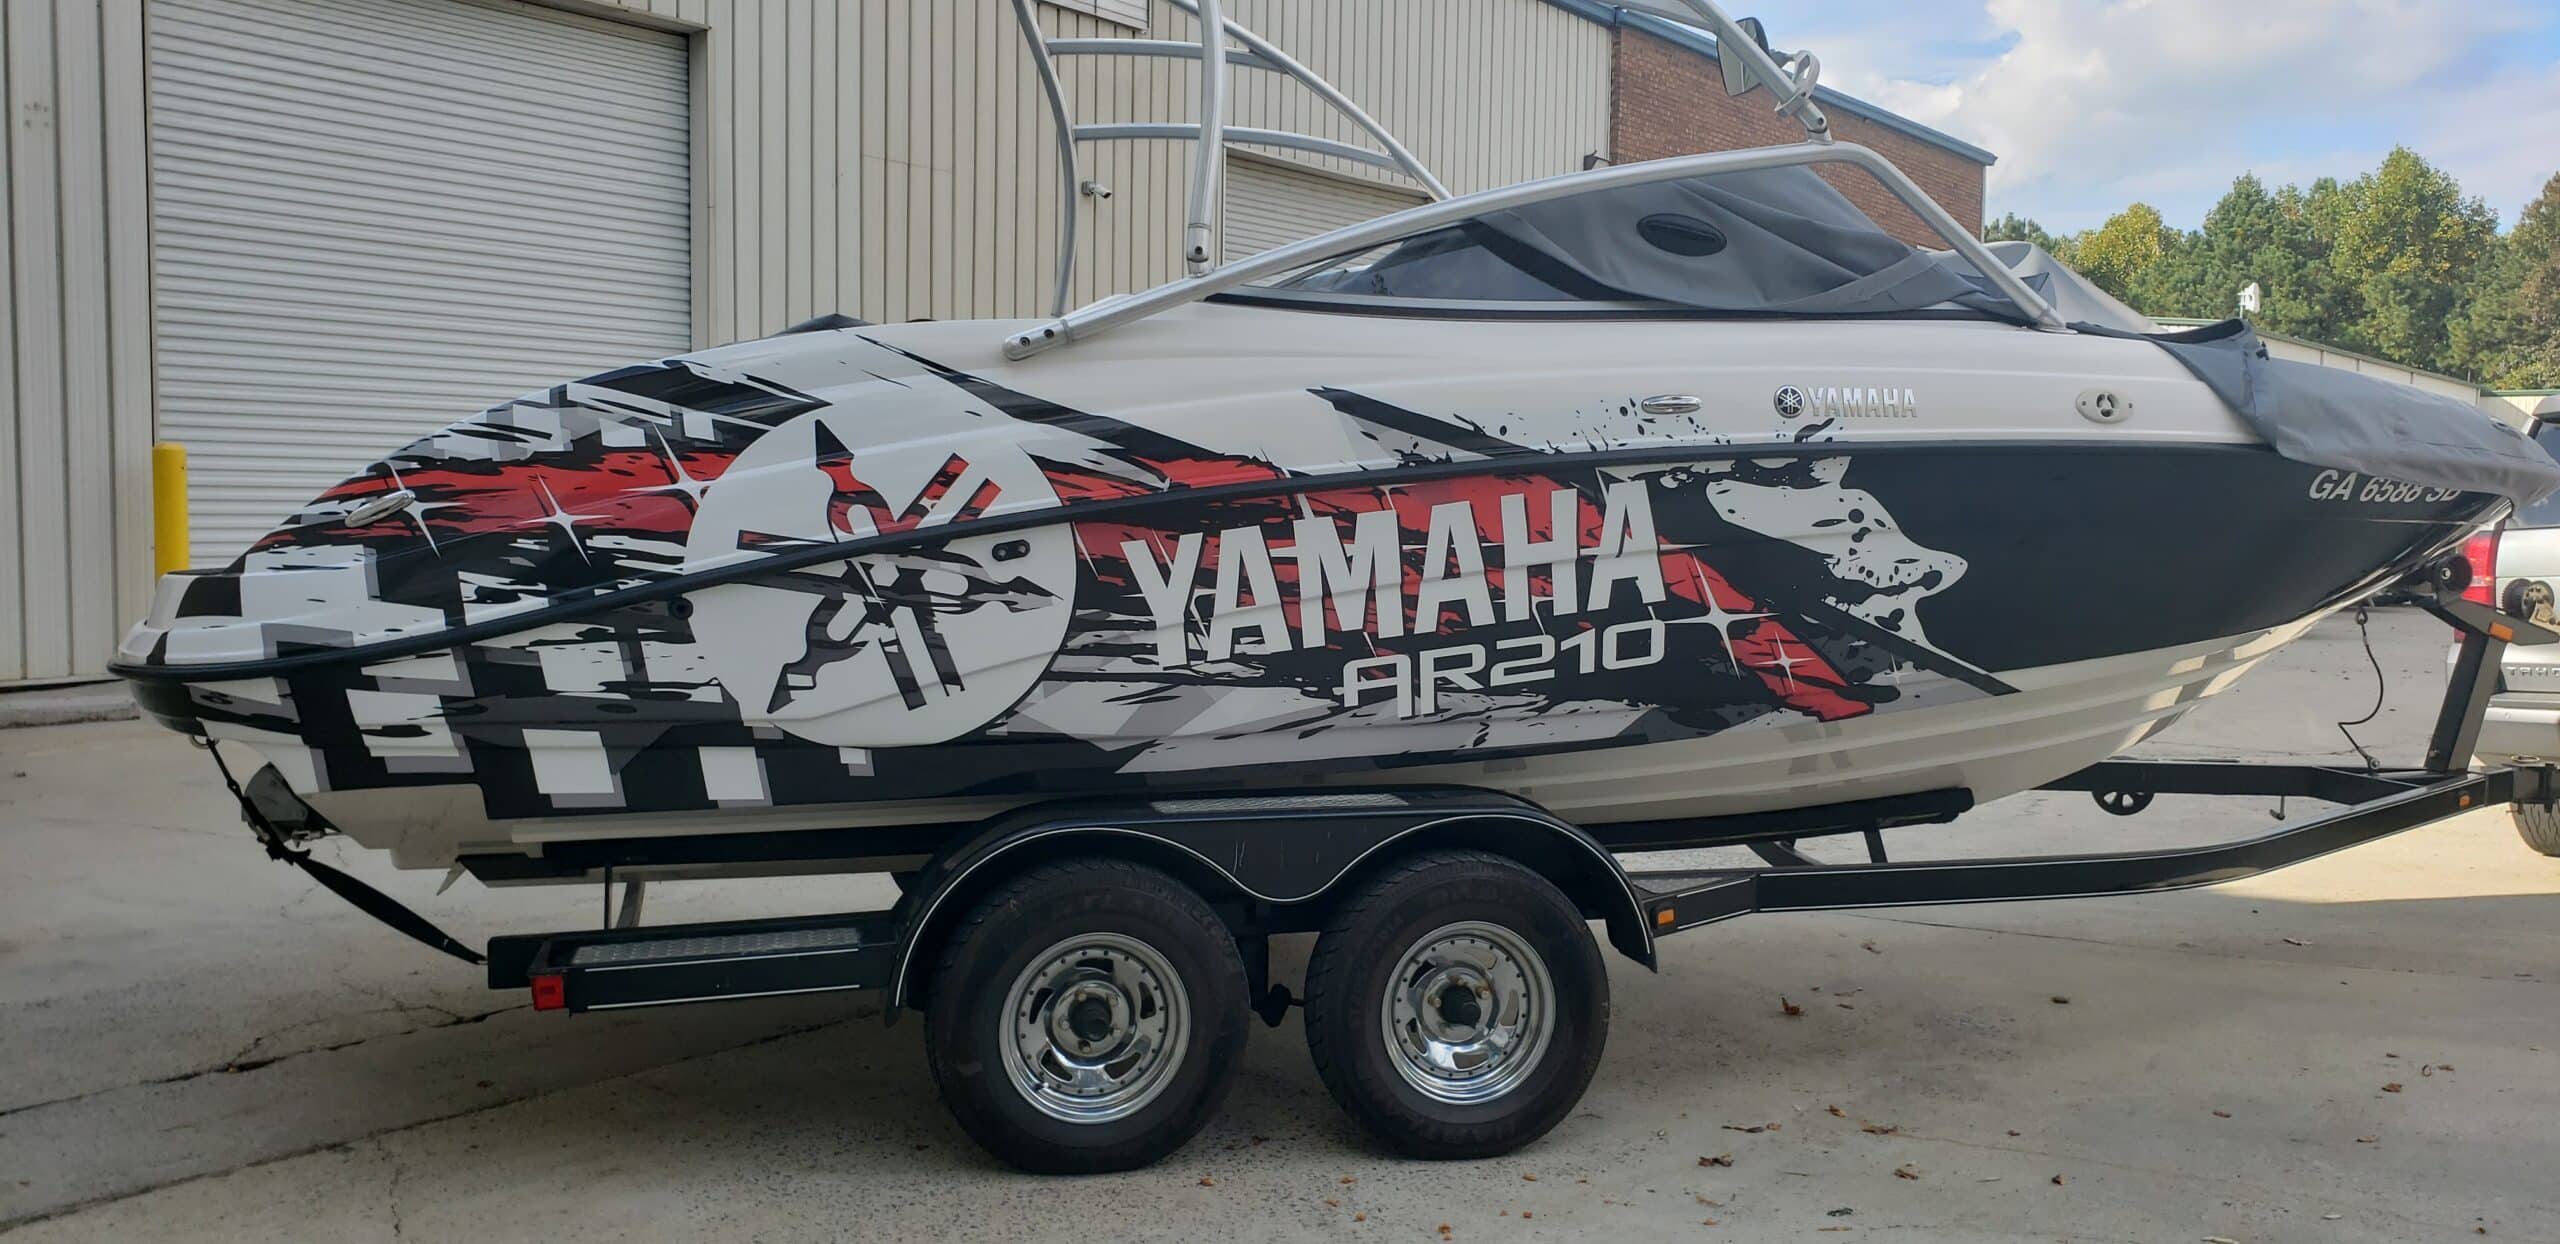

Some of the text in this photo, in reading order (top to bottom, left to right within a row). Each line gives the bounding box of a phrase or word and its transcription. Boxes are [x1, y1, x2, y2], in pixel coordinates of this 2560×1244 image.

[1806, 387, 1918, 417] YAMAHA
[2309, 469, 2357, 500] GA
[1120, 480, 1666, 670] YAMAHA
[1342, 619, 1666, 718] AR210
